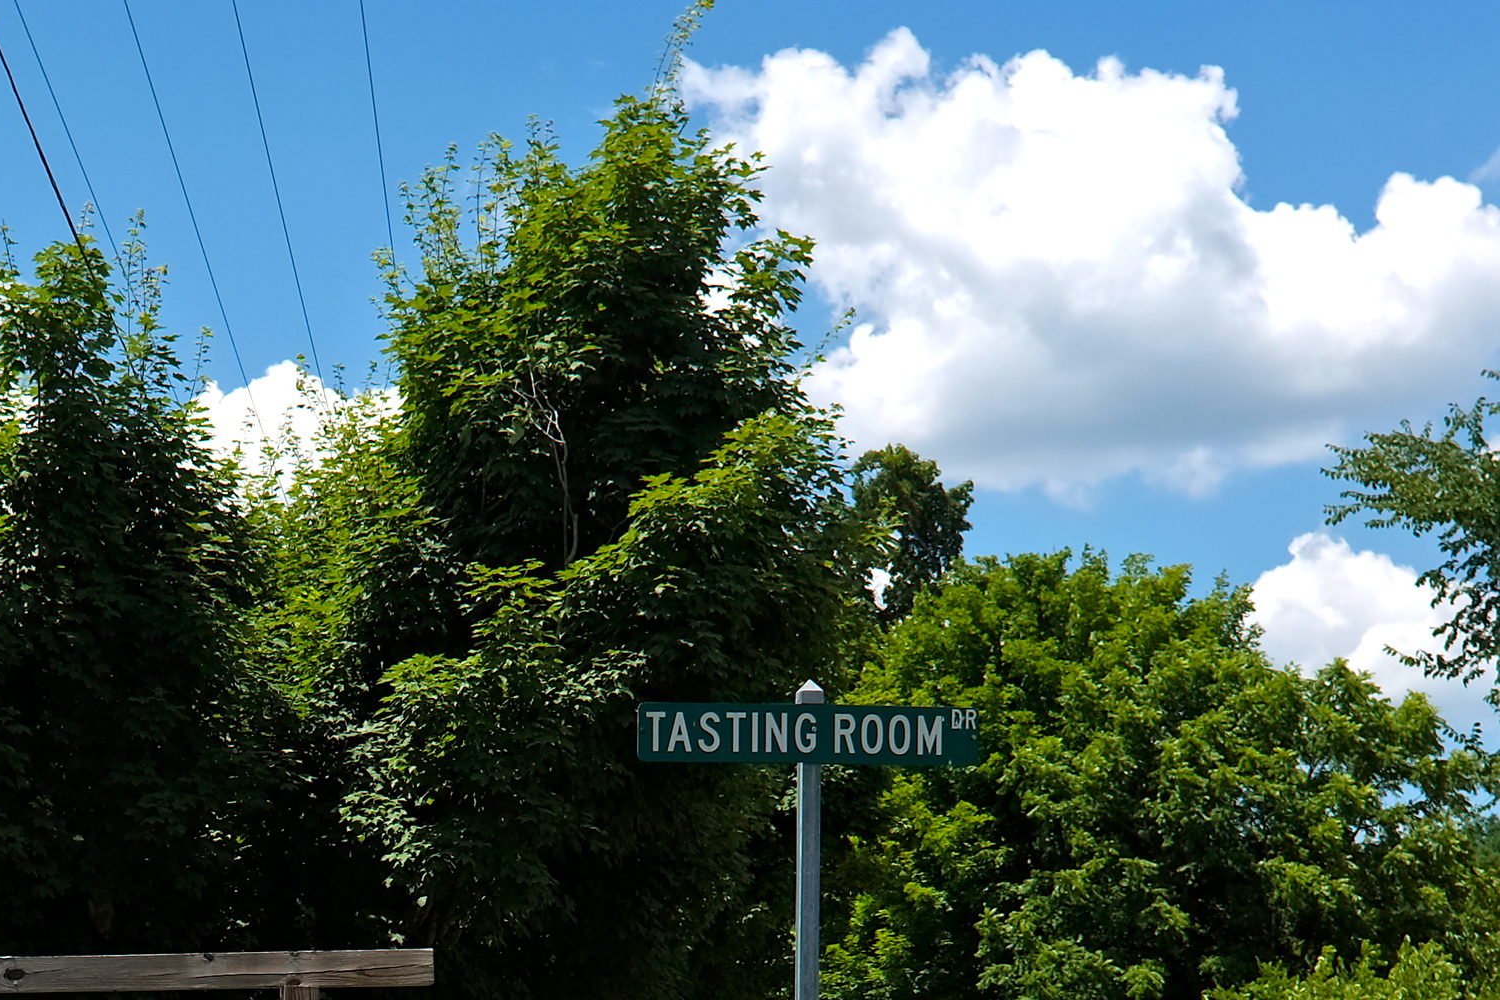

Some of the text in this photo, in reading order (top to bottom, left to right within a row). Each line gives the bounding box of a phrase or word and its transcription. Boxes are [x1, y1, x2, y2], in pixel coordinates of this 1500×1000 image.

[646, 709, 977, 755] TASTING ROOM DR
